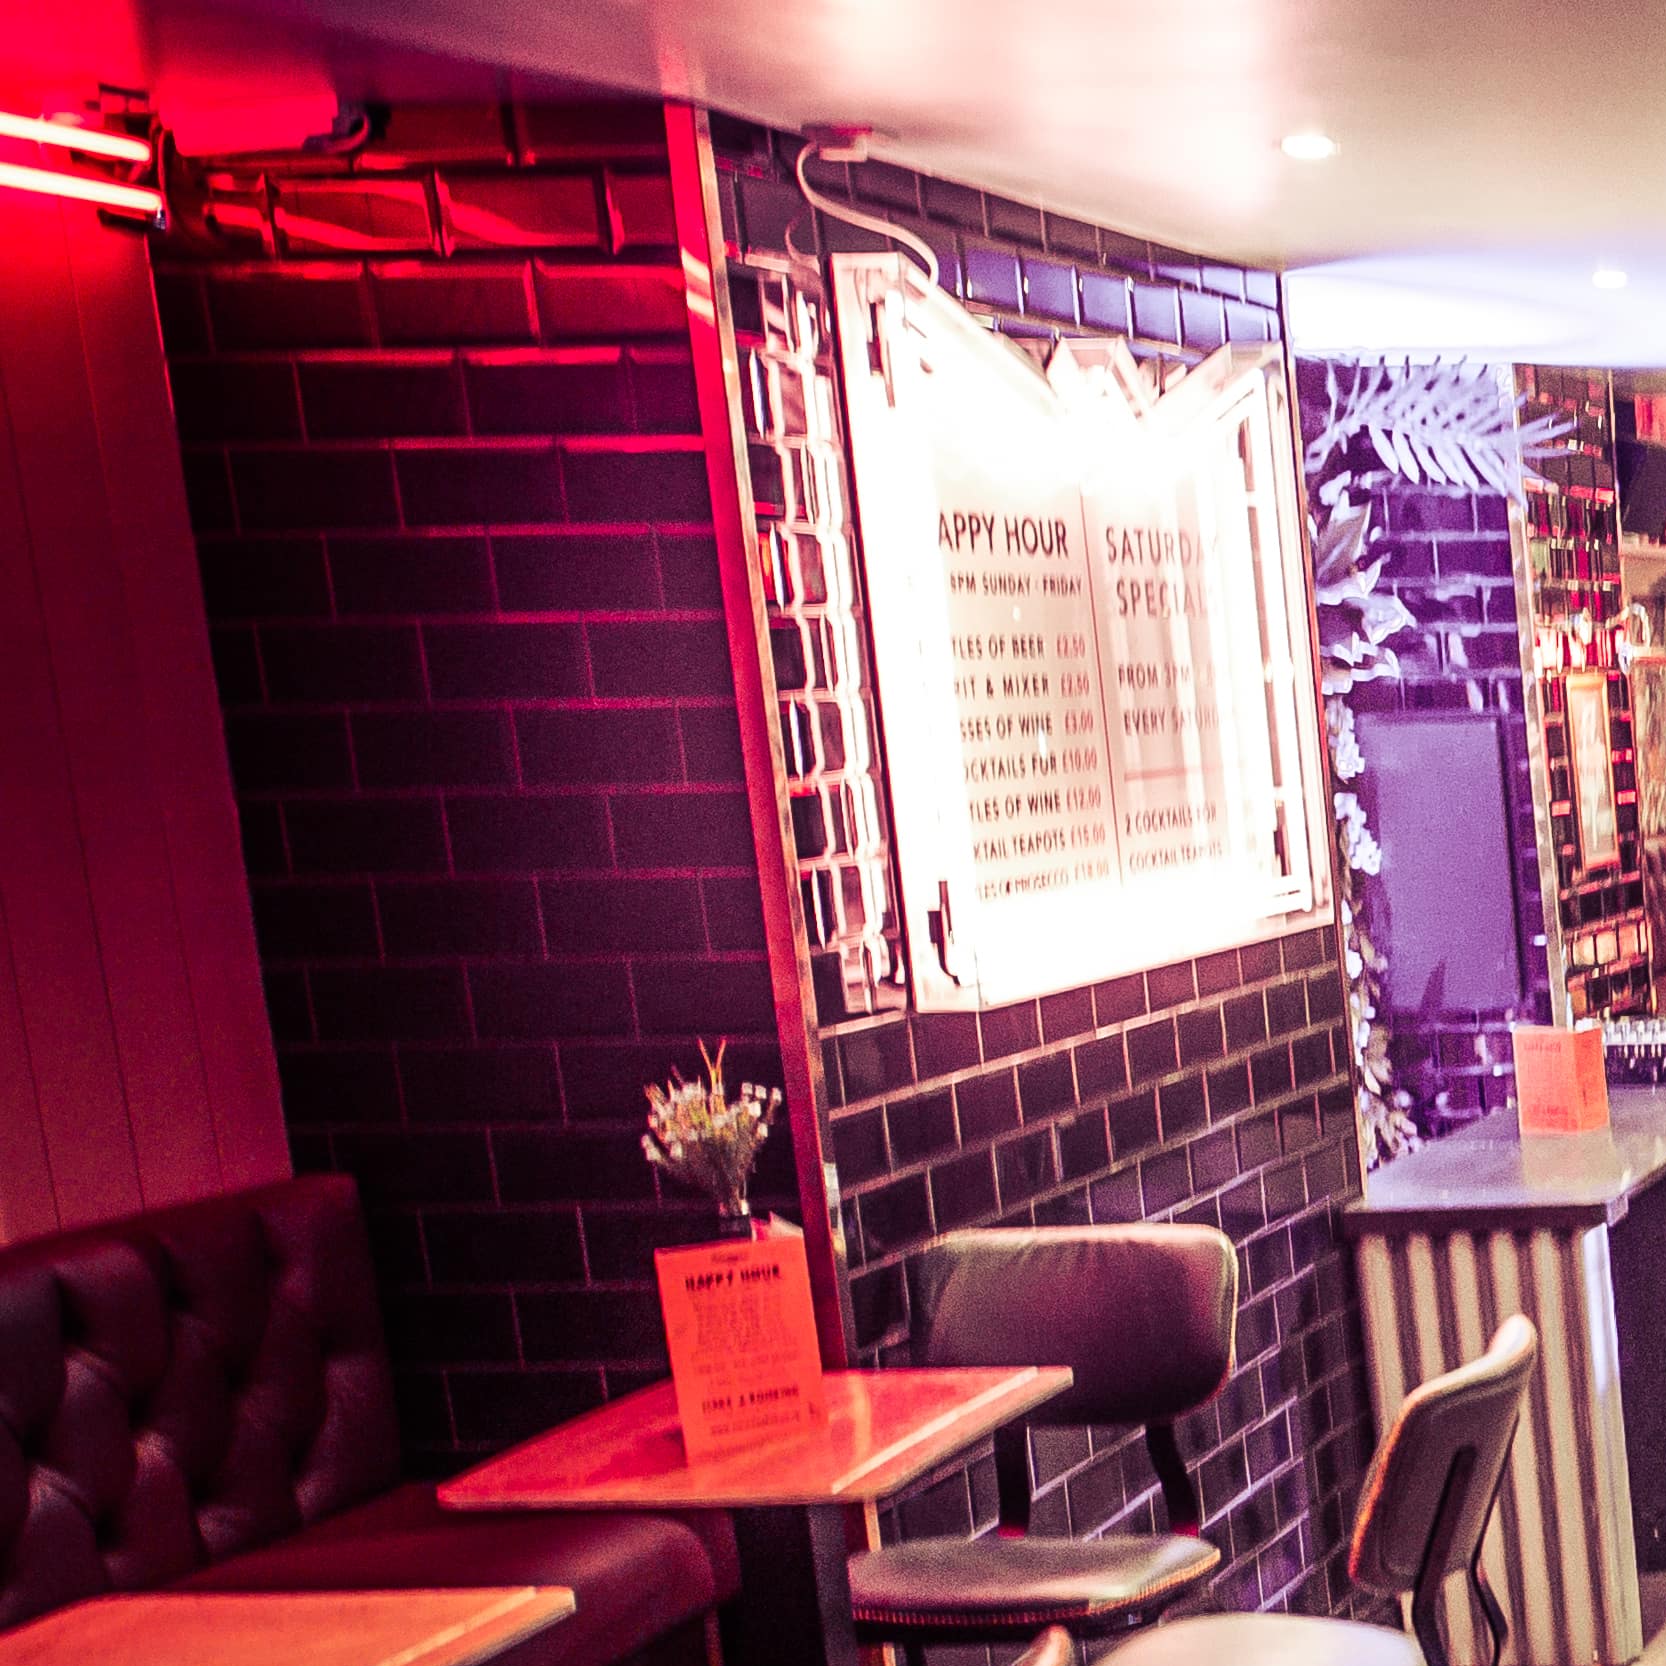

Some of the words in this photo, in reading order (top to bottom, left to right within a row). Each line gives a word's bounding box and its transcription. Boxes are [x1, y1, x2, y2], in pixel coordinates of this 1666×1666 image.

[938, 511, 995, 554] APPY
[1003, 515, 1069, 559] HOUR
[1105, 525, 1217, 567] SATURD
[982, 571, 1031, 597] SUNDAY
[1042, 573, 1083, 598] FRIDAY
[1116, 575, 1208, 619] SPECIAL
[952, 633, 983, 660] TLES
[988, 633, 1006, 660] OF
[1011, 633, 1045, 660] BEER
[1002, 673, 1050, 698] MIXER
[1118, 662, 1159, 690] FROM
[959, 715, 992, 743] SSES
[996, 713, 1013, 741] OF
[1018, 711, 1053, 738] WINE
[1123, 709, 1166, 737] EVERY
[964, 752, 1026, 783] CKTAILS
[1061, 747, 1098, 775] £10.00
[969, 797, 1000, 824] TLES
[1005, 793, 1022, 820] OF
[1027, 788, 1061, 816] WINE
[1135, 803, 1193, 836] COCKTAILS
[973, 836, 1008, 864] KTAIL
[1013, 826, 1066, 857] TEAPOTS
[1129, 845, 1178, 874] COCKTAIL
